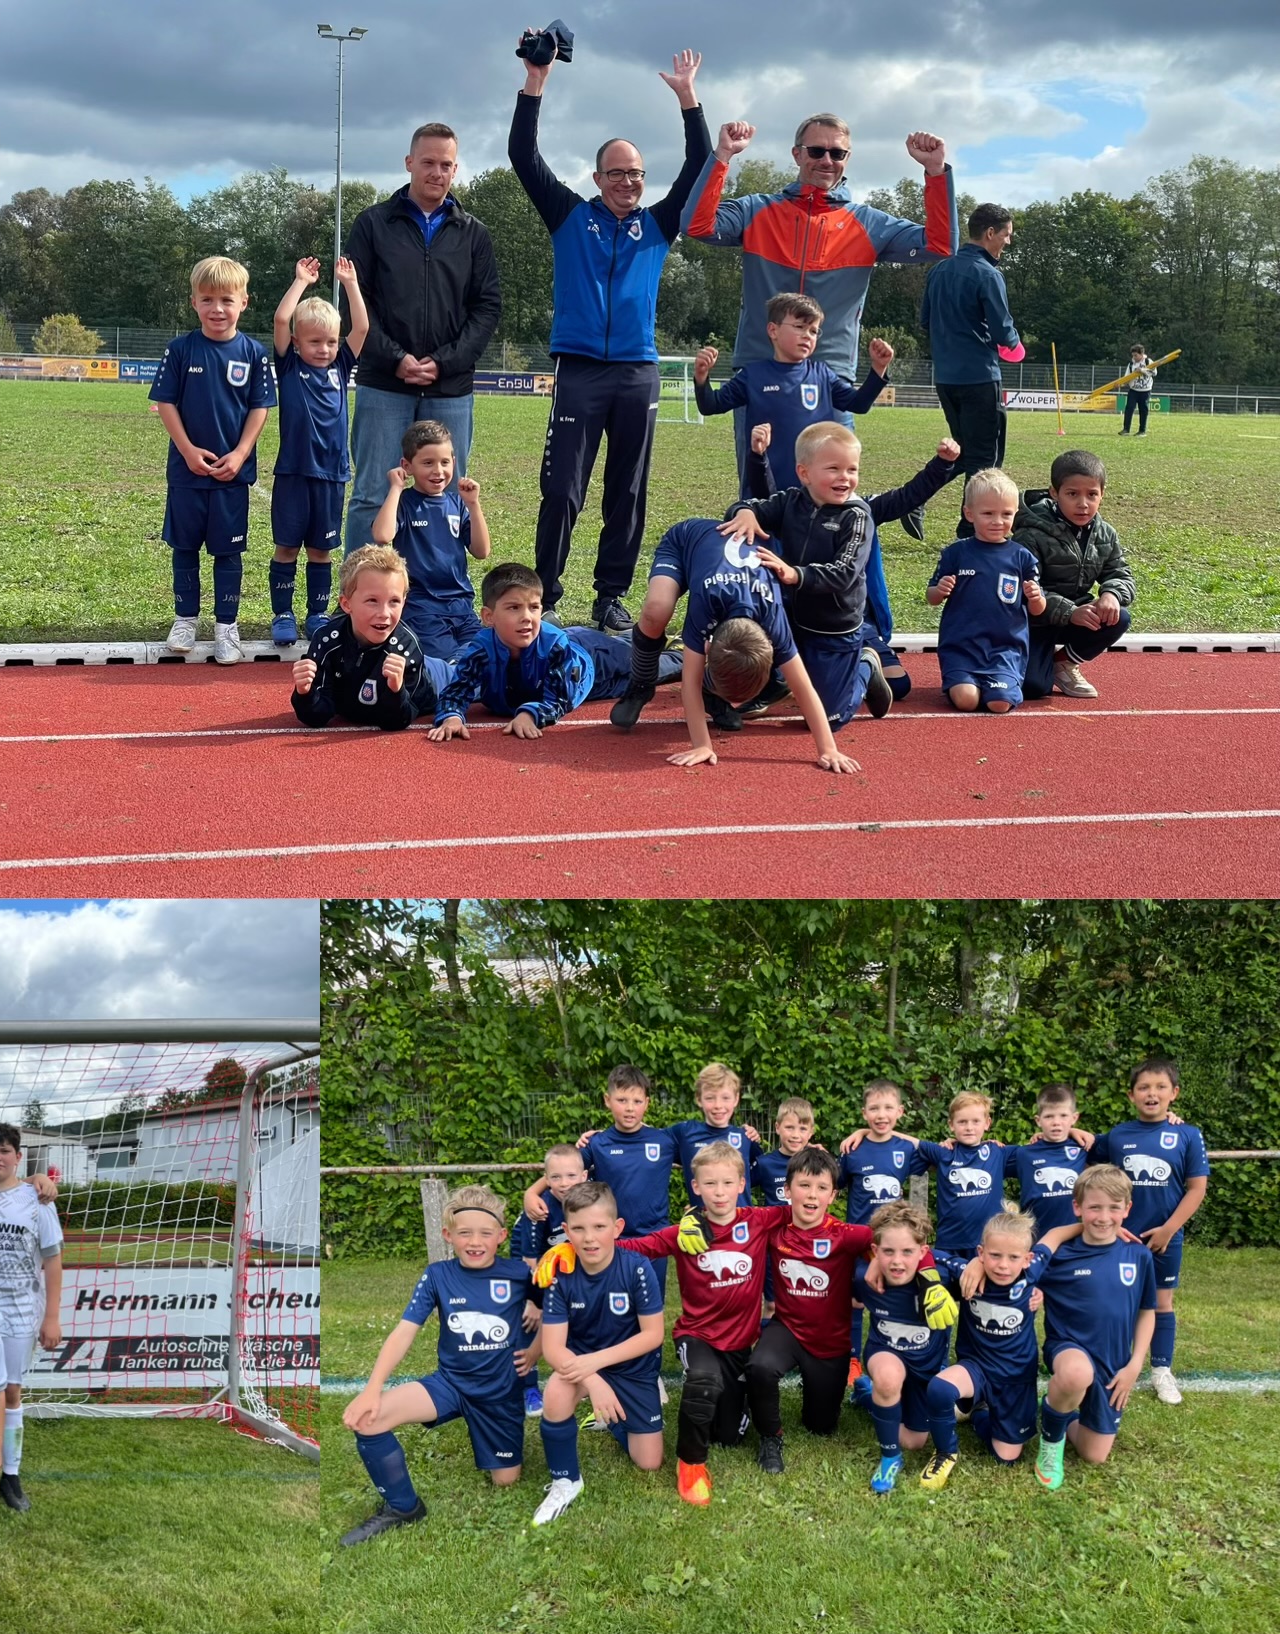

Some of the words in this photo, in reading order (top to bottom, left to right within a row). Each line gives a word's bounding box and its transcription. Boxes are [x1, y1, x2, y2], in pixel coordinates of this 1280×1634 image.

[497, 377, 533, 390] EnBW
[662, 380, 680, 390] post
[231, 535, 244, 543] JAKO
[325, 530, 336, 539] JAKO
[709, 1273, 752, 1289] reindersart
[75, 1288, 218, 1311] Hermann
[875, 1308, 889, 1316] JAKO
[458, 1340, 510, 1352] reindersart
[119, 1356, 178, 1369] Tanken
[181, 1355, 223, 1369] rund
[260, 1355, 286, 1368] die
